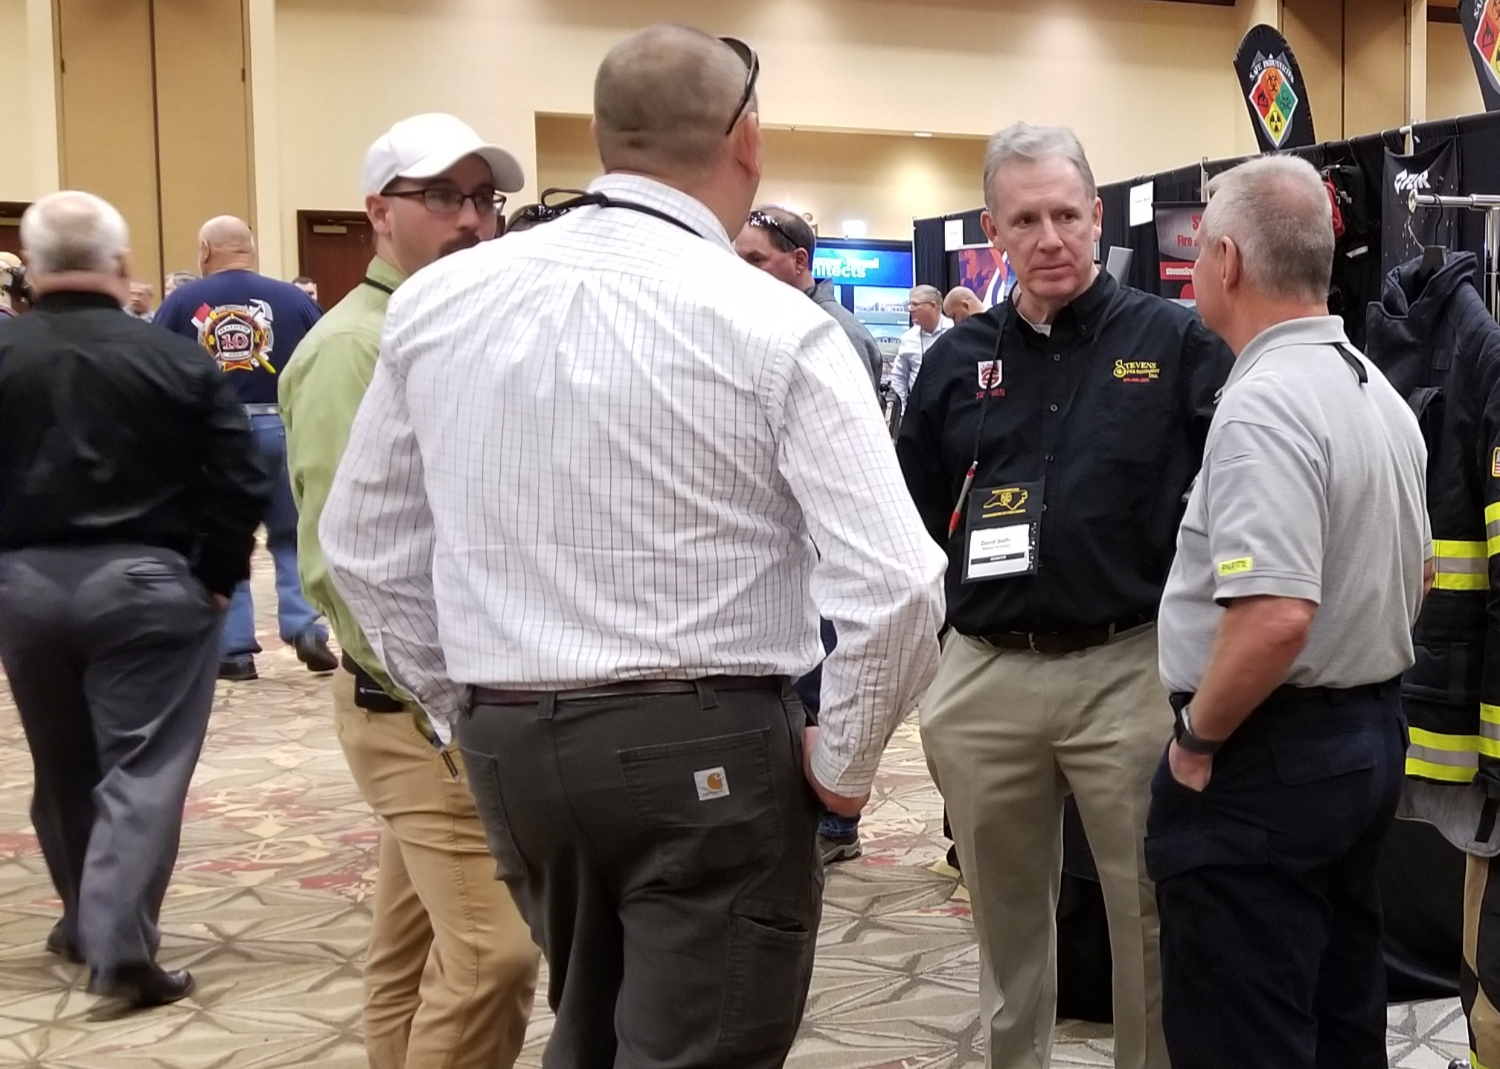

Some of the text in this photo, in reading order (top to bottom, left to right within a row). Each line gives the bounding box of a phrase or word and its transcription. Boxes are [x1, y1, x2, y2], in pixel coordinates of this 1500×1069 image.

[1177, 234, 1193, 247] Fire
[221, 332, 249, 350] 10
[1113, 359, 1157, 378] STEVENS
